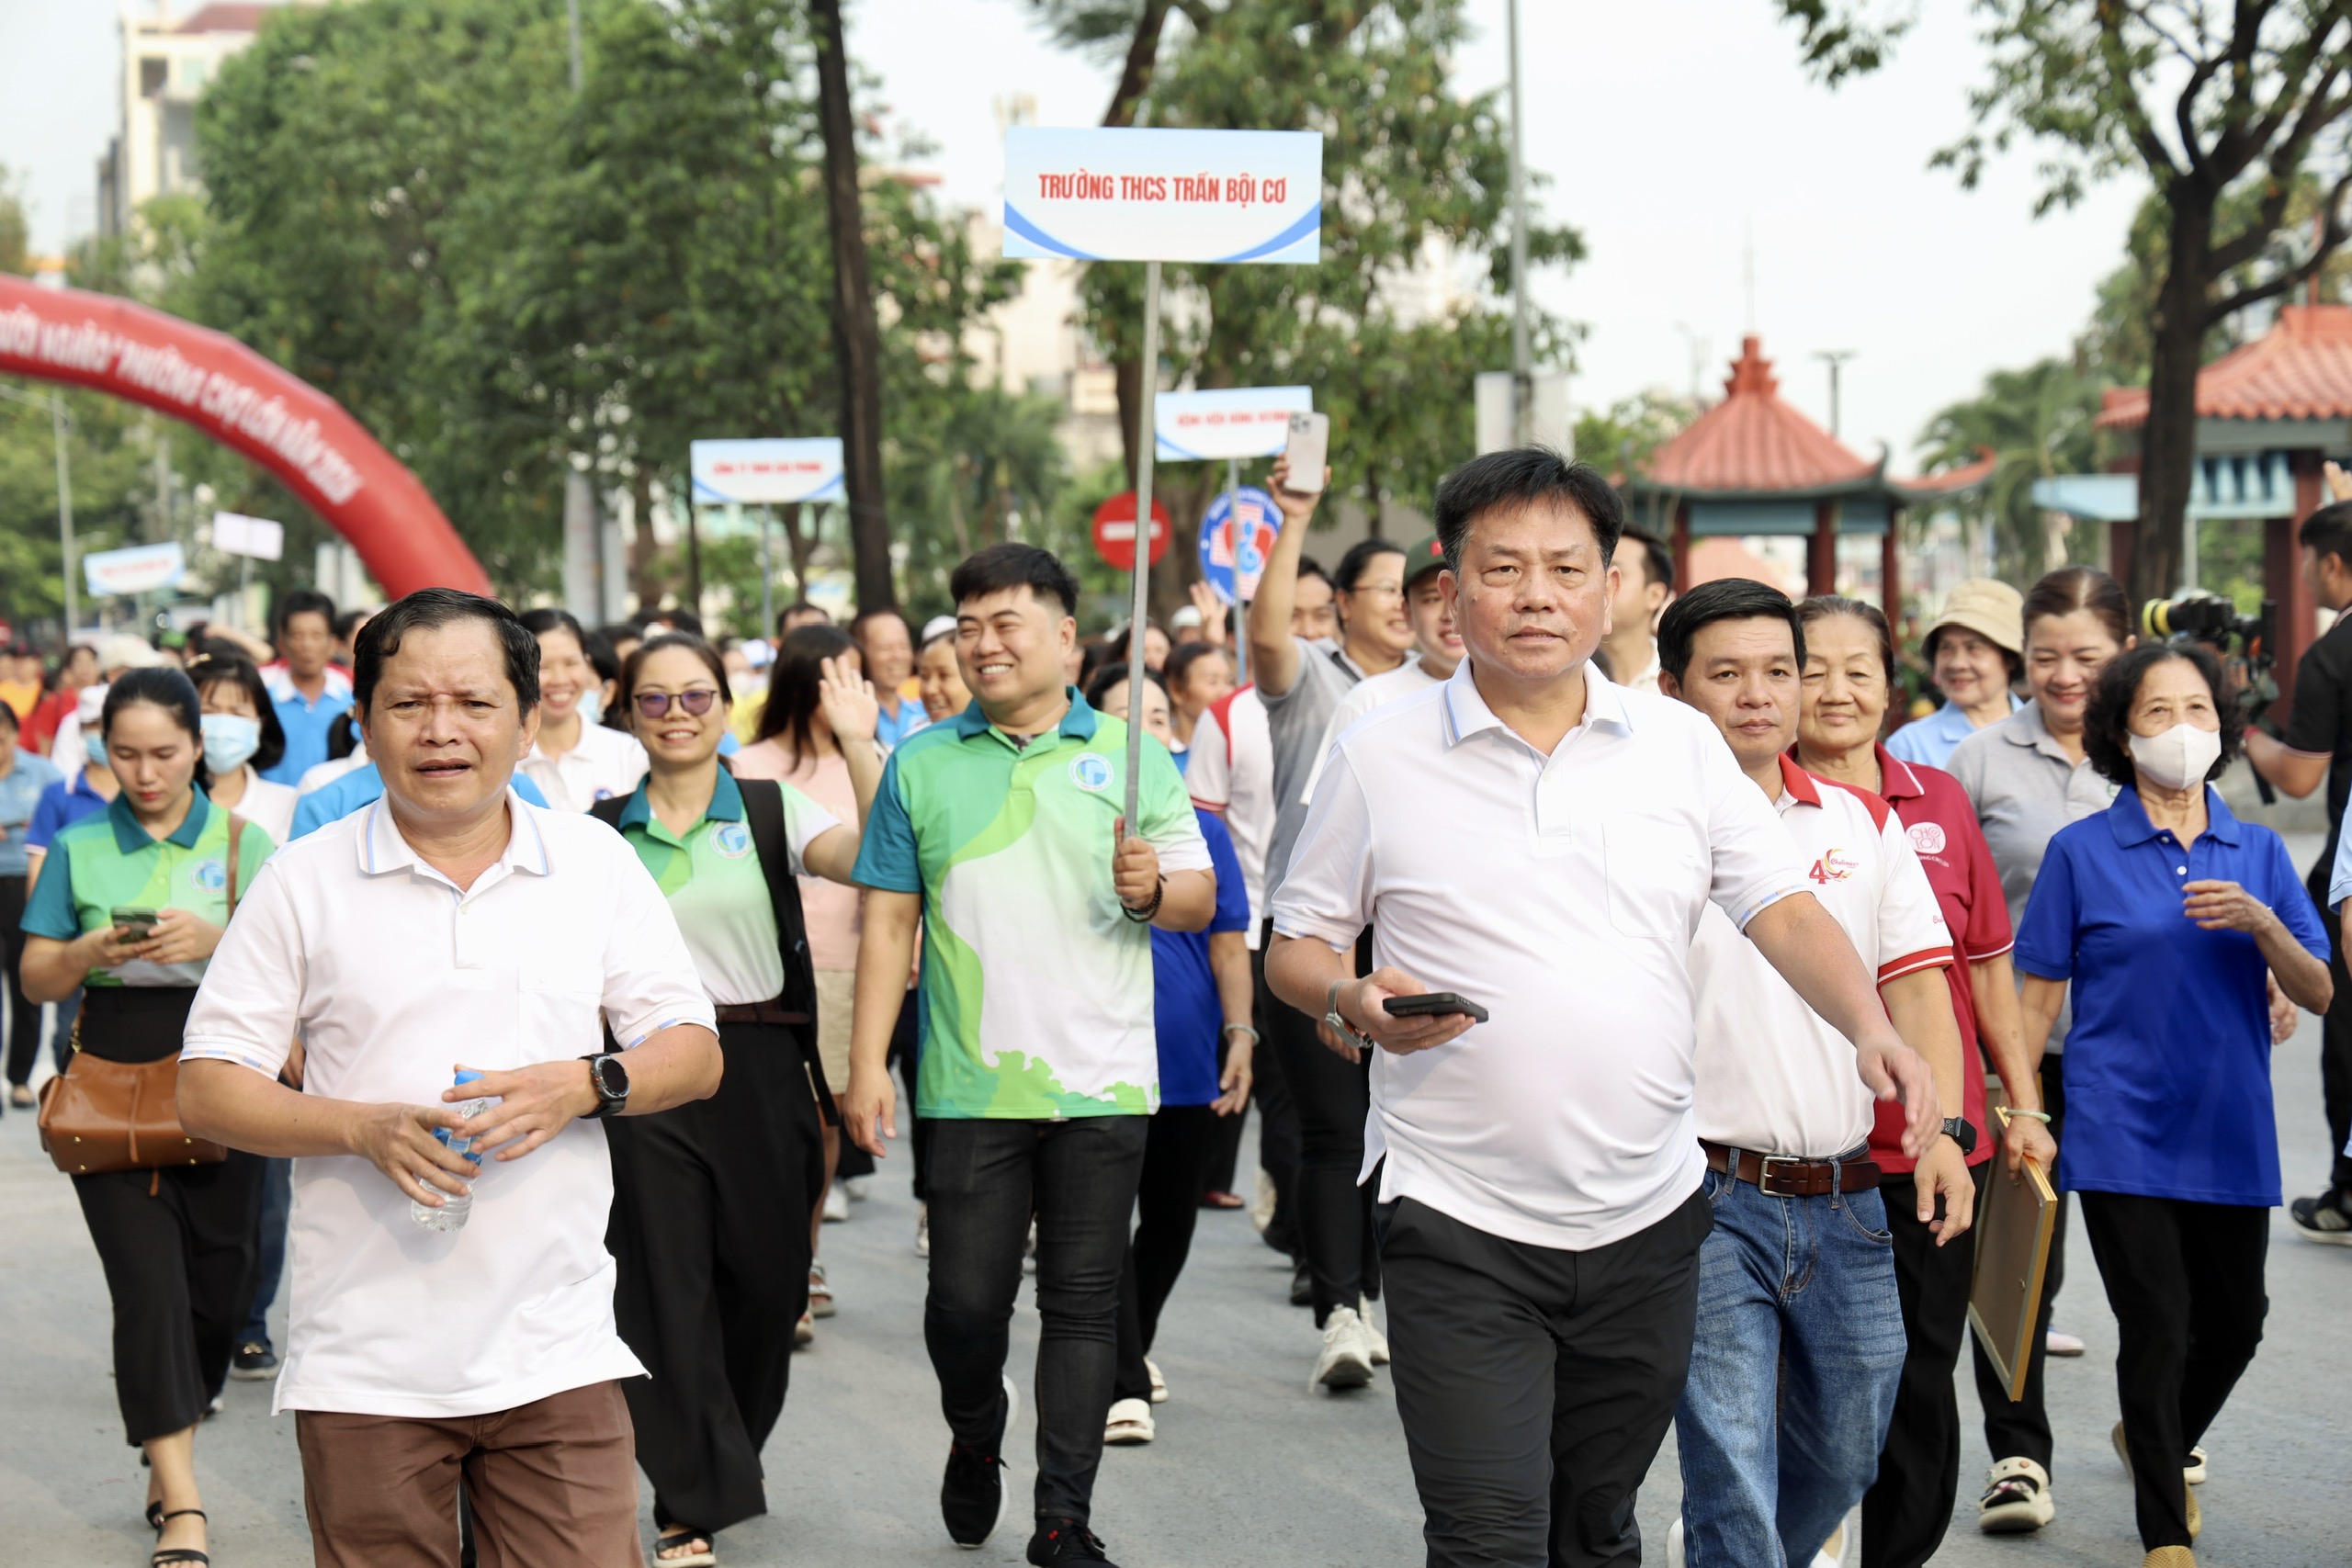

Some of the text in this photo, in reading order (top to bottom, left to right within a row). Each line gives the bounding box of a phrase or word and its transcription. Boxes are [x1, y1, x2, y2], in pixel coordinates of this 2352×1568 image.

[1039, 167, 1114, 199] TRƯỜNG
[1120, 175, 1167, 200] THCS
[1227, 172, 1256, 209] BỘI
[1262, 175, 1286, 203] CƠ
